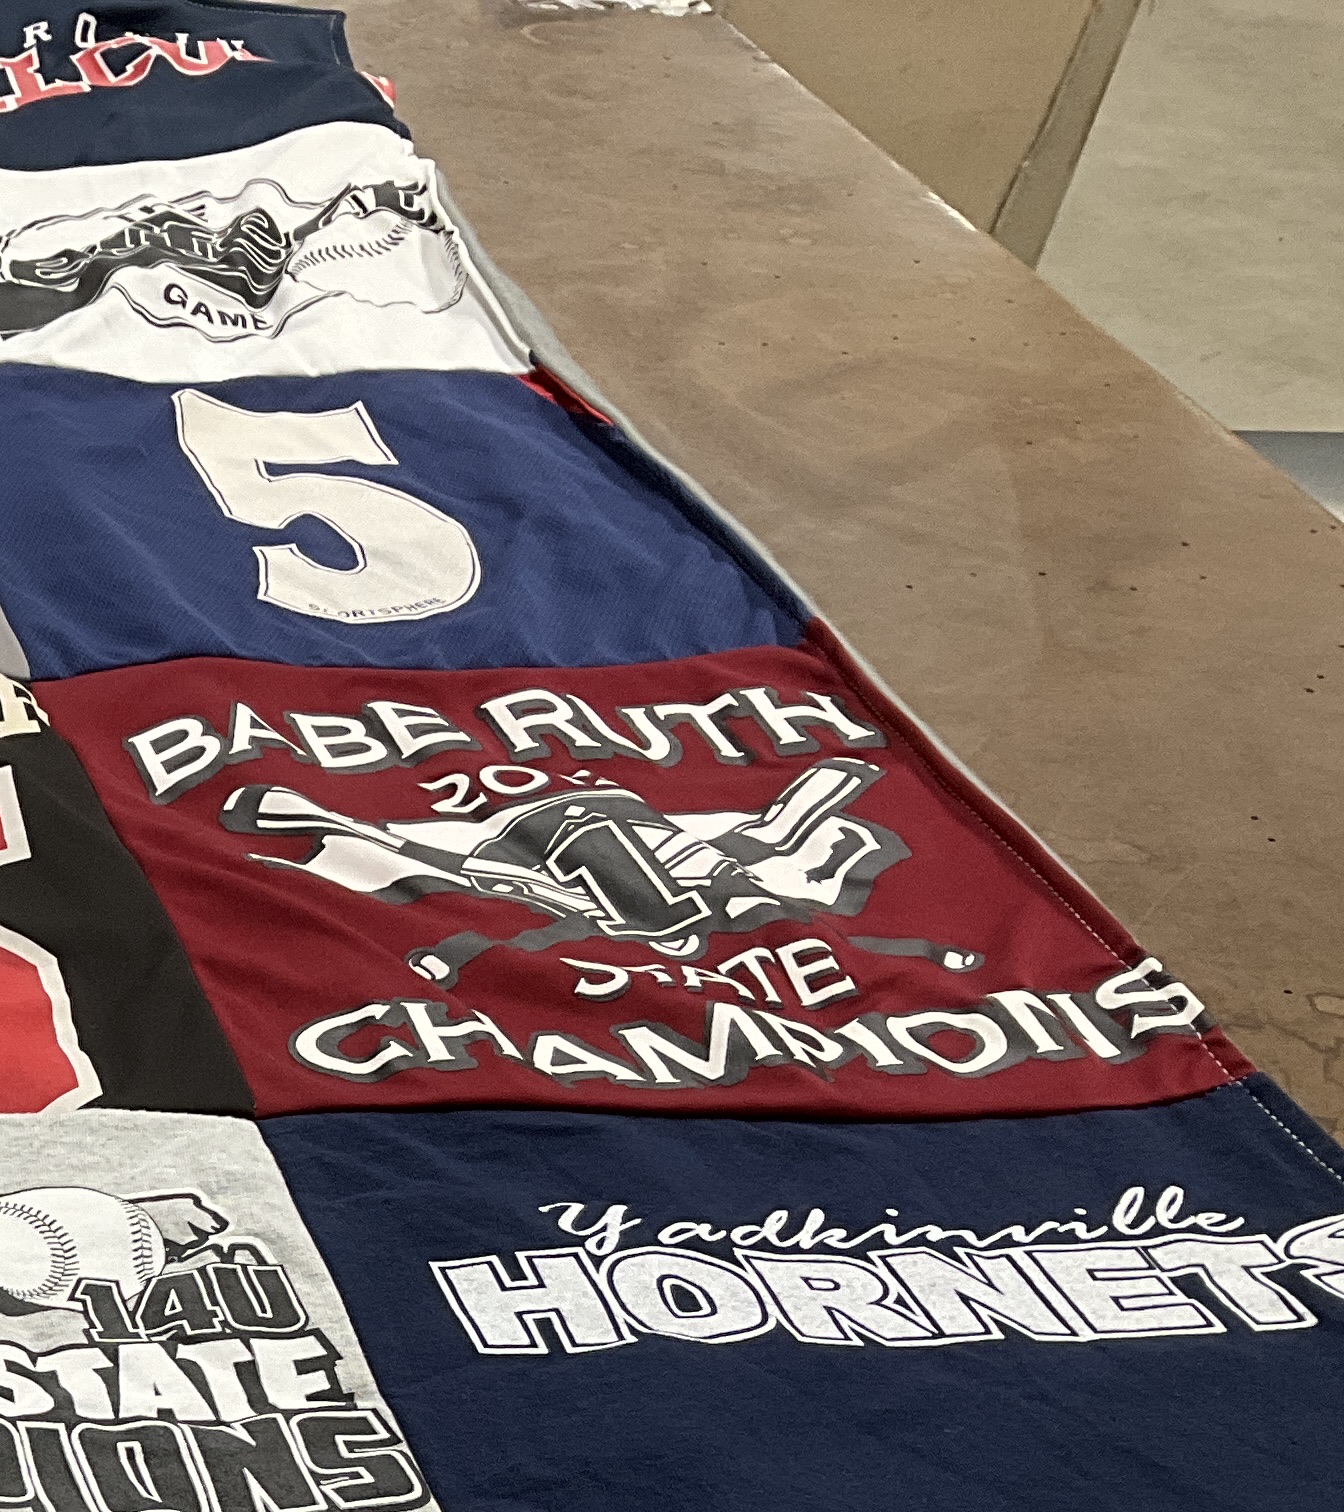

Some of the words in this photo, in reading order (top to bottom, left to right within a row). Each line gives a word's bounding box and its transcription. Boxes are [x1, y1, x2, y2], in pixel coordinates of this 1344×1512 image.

[162, 282, 275, 333] GAME
[170, 387, 482, 625] 5
[126, 699, 469, 802] BABE
[480, 686, 882, 766] RUTH
[417, 764, 619, 814] 20
[286, 957, 1206, 1087] CHAMPIONS
[538, 1185, 1248, 1254] Yadkinville
[70, 1263, 312, 1345] 14U
